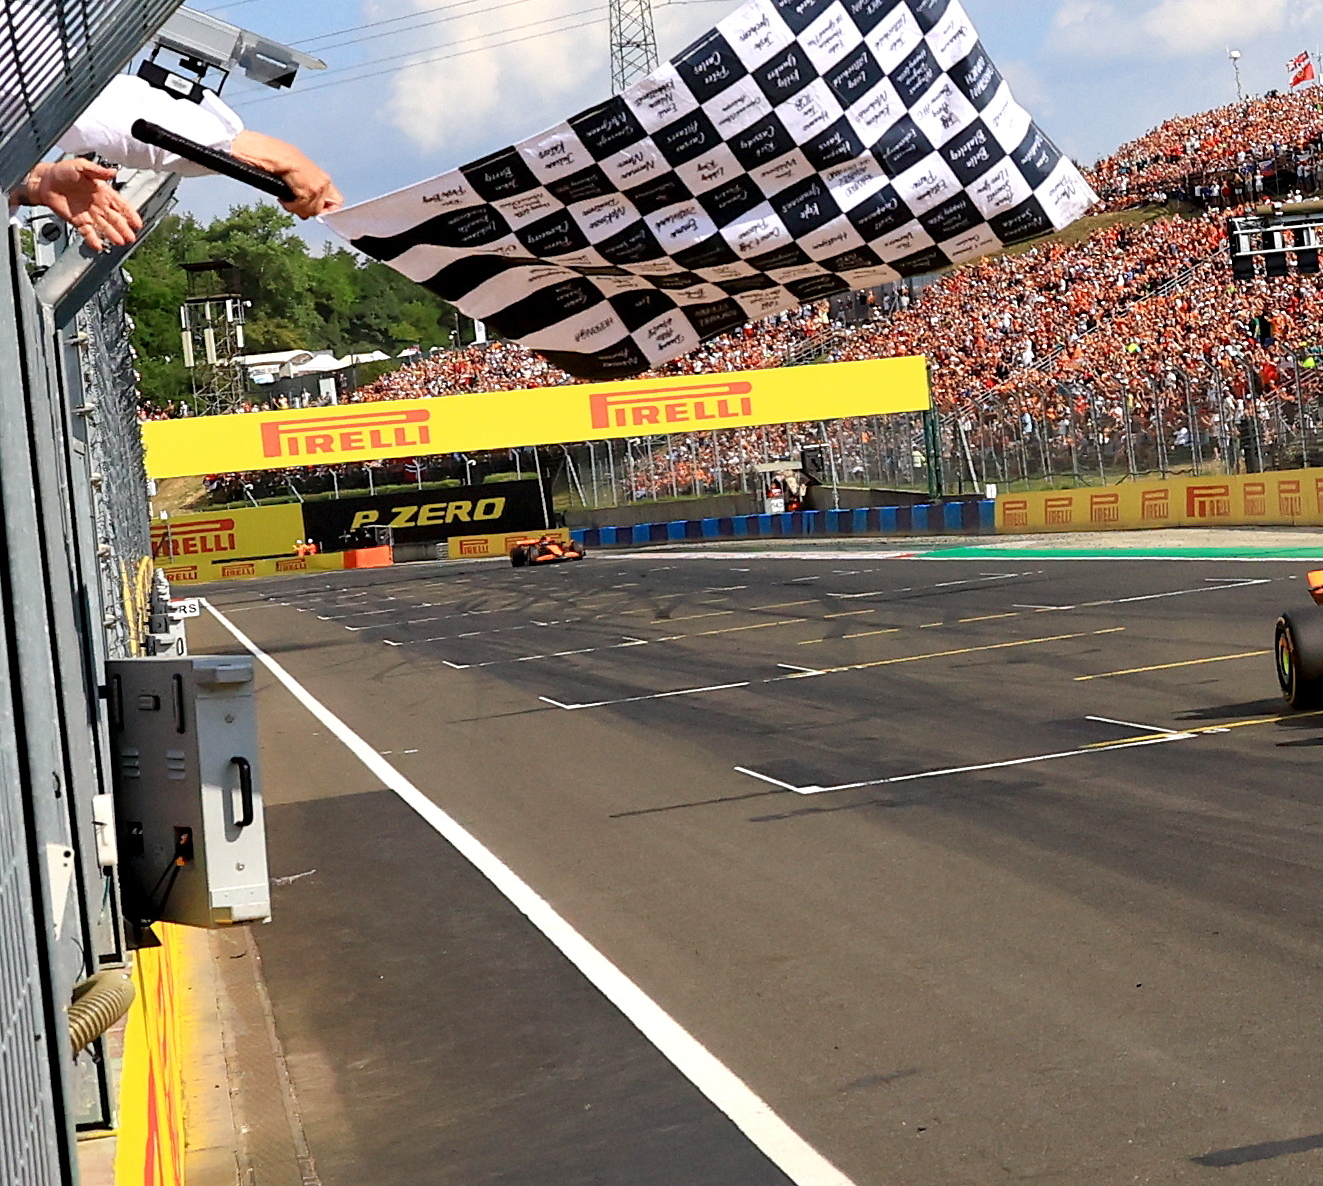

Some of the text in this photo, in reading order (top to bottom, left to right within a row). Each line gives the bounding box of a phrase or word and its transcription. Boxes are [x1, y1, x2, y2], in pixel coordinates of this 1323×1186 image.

[589, 381, 752, 429] PIRELLI
[260, 409, 431, 458] PIRELLI
[351, 497, 505, 532] P ZERO
